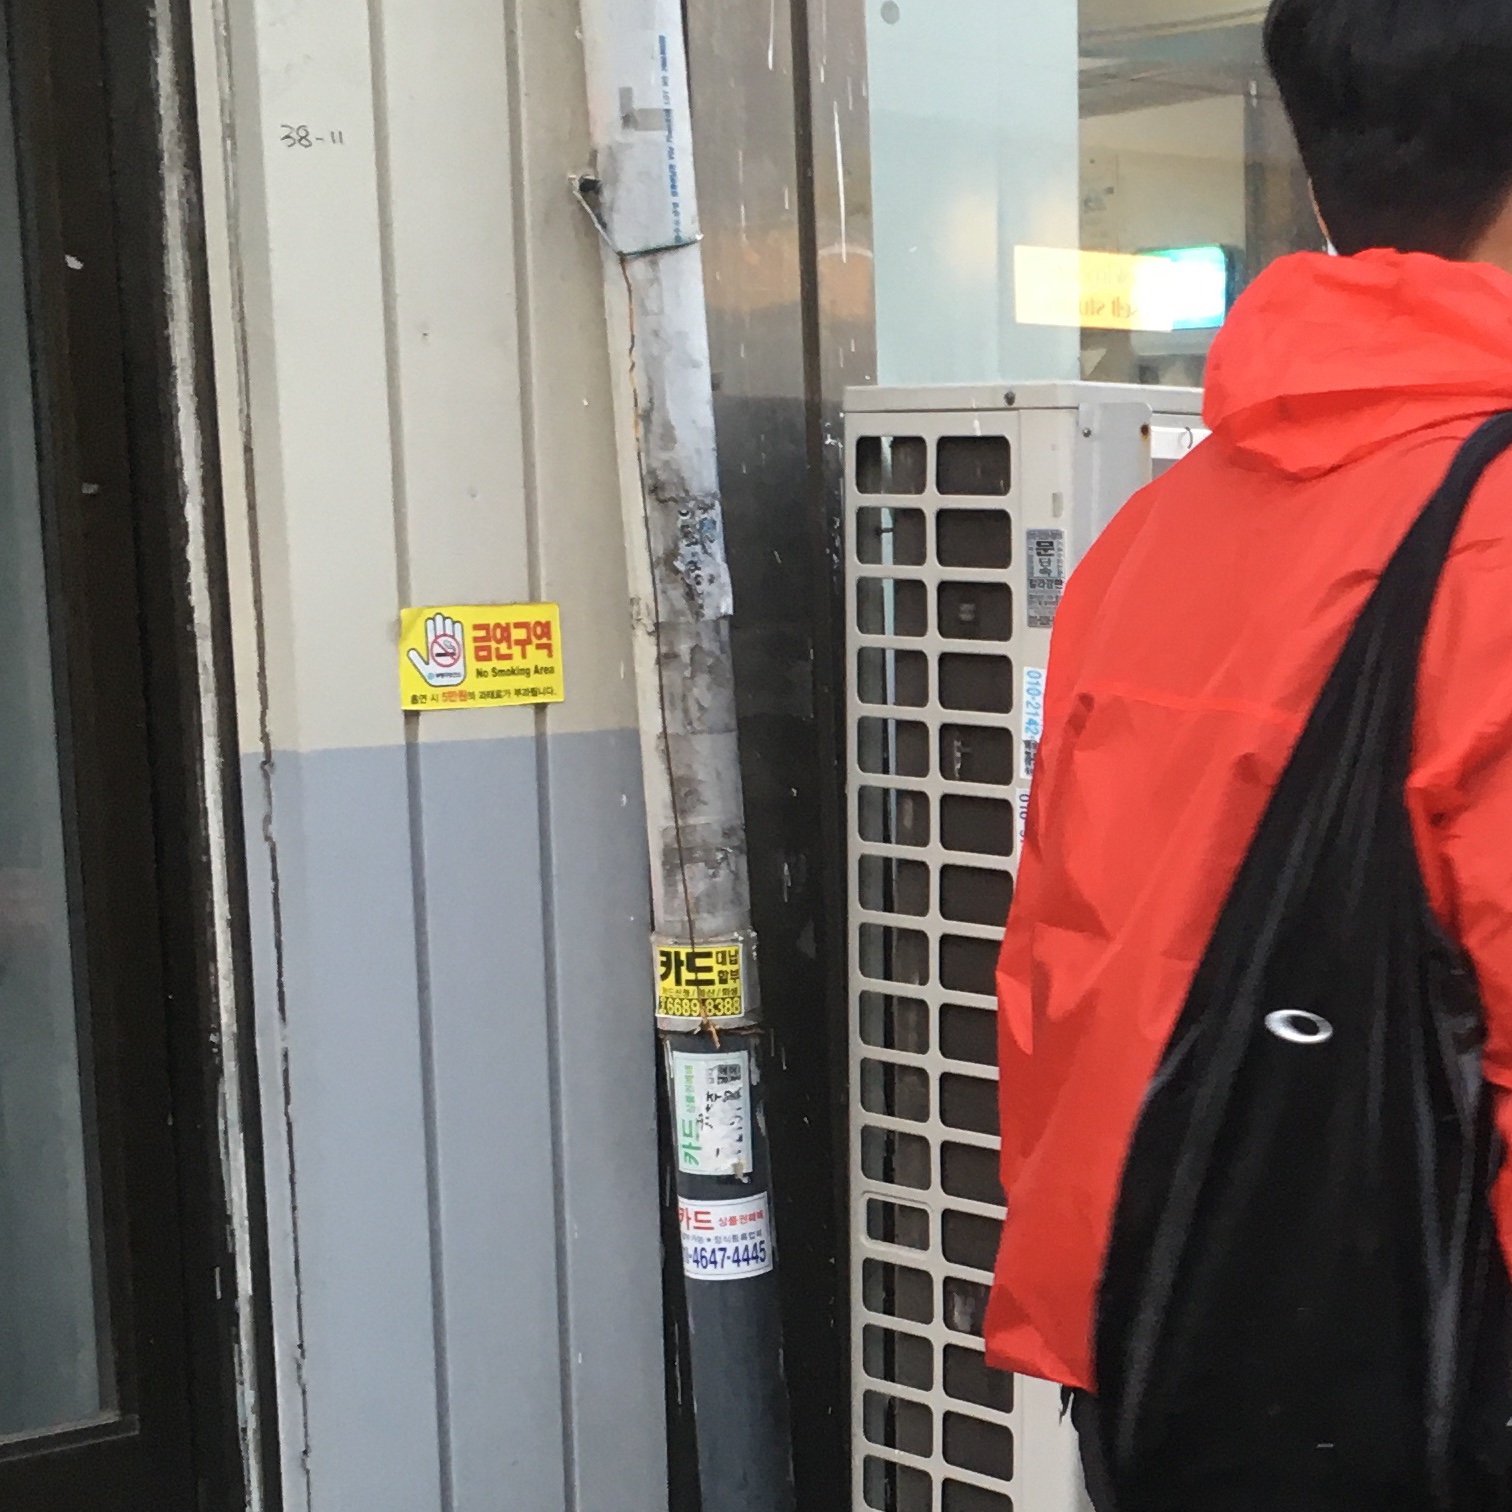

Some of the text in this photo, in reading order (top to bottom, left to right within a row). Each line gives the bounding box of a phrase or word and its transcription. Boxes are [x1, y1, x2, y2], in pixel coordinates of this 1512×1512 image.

[280, 124, 344, 149] 38-11
[472, 620, 554, 662] 금연구역
[476, 668, 489, 679] No
[491, 666, 531, 679] Smoking
[533, 665, 555, 675] Area
[659, 949, 716, 987] 카드
[682, 1119, 702, 1166] 카드
